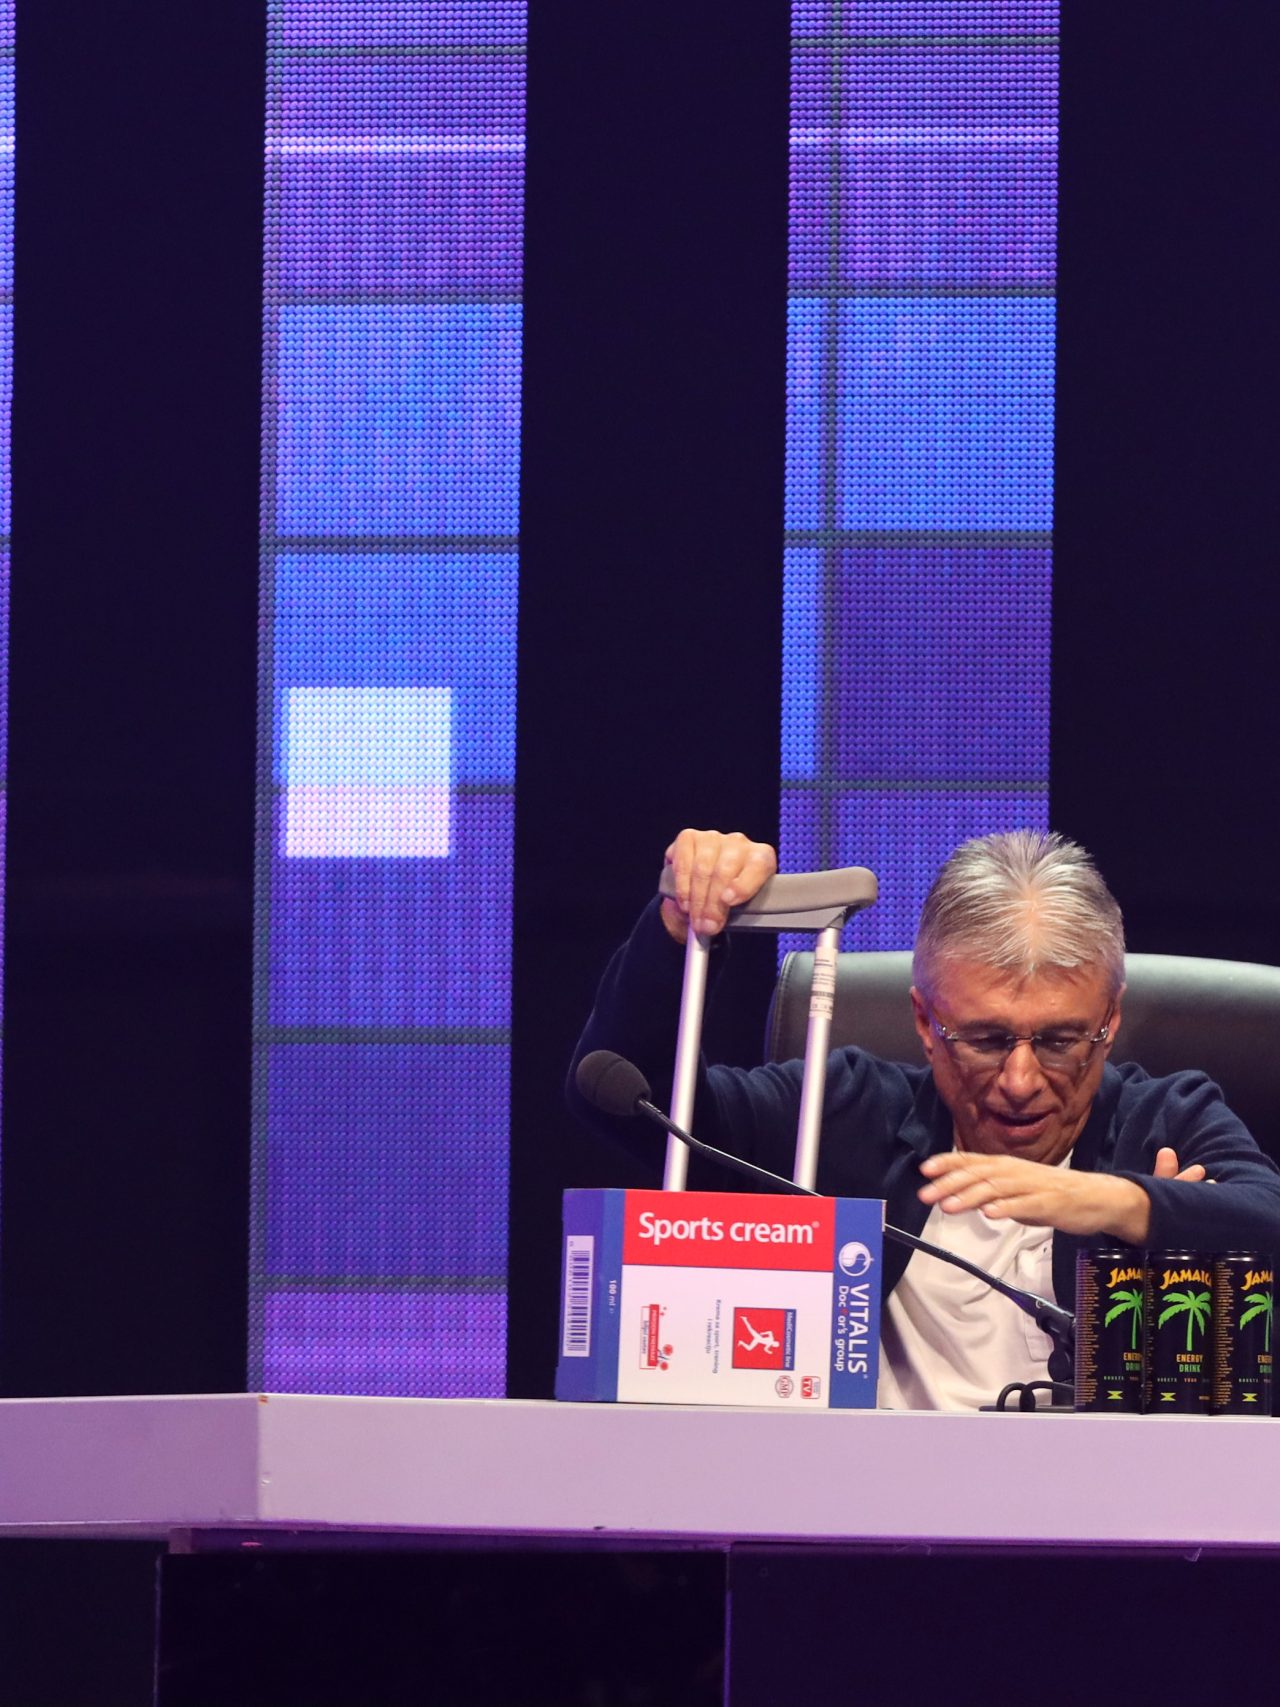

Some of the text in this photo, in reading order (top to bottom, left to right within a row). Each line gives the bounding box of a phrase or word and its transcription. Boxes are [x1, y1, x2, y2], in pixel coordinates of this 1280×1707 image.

[638, 1211, 725, 1246] Sports
[607, 1279, 618, 1295] 100
[607, 1296, 616, 1307] ml
[847, 1282, 871, 1374] VITALIS
[833, 1338, 846, 1372] group
[1176, 1353, 1204, 1363] ENERGY
[1179, 1363, 1201, 1373] DRINK
[779, 1377, 789, 1397] GMP
